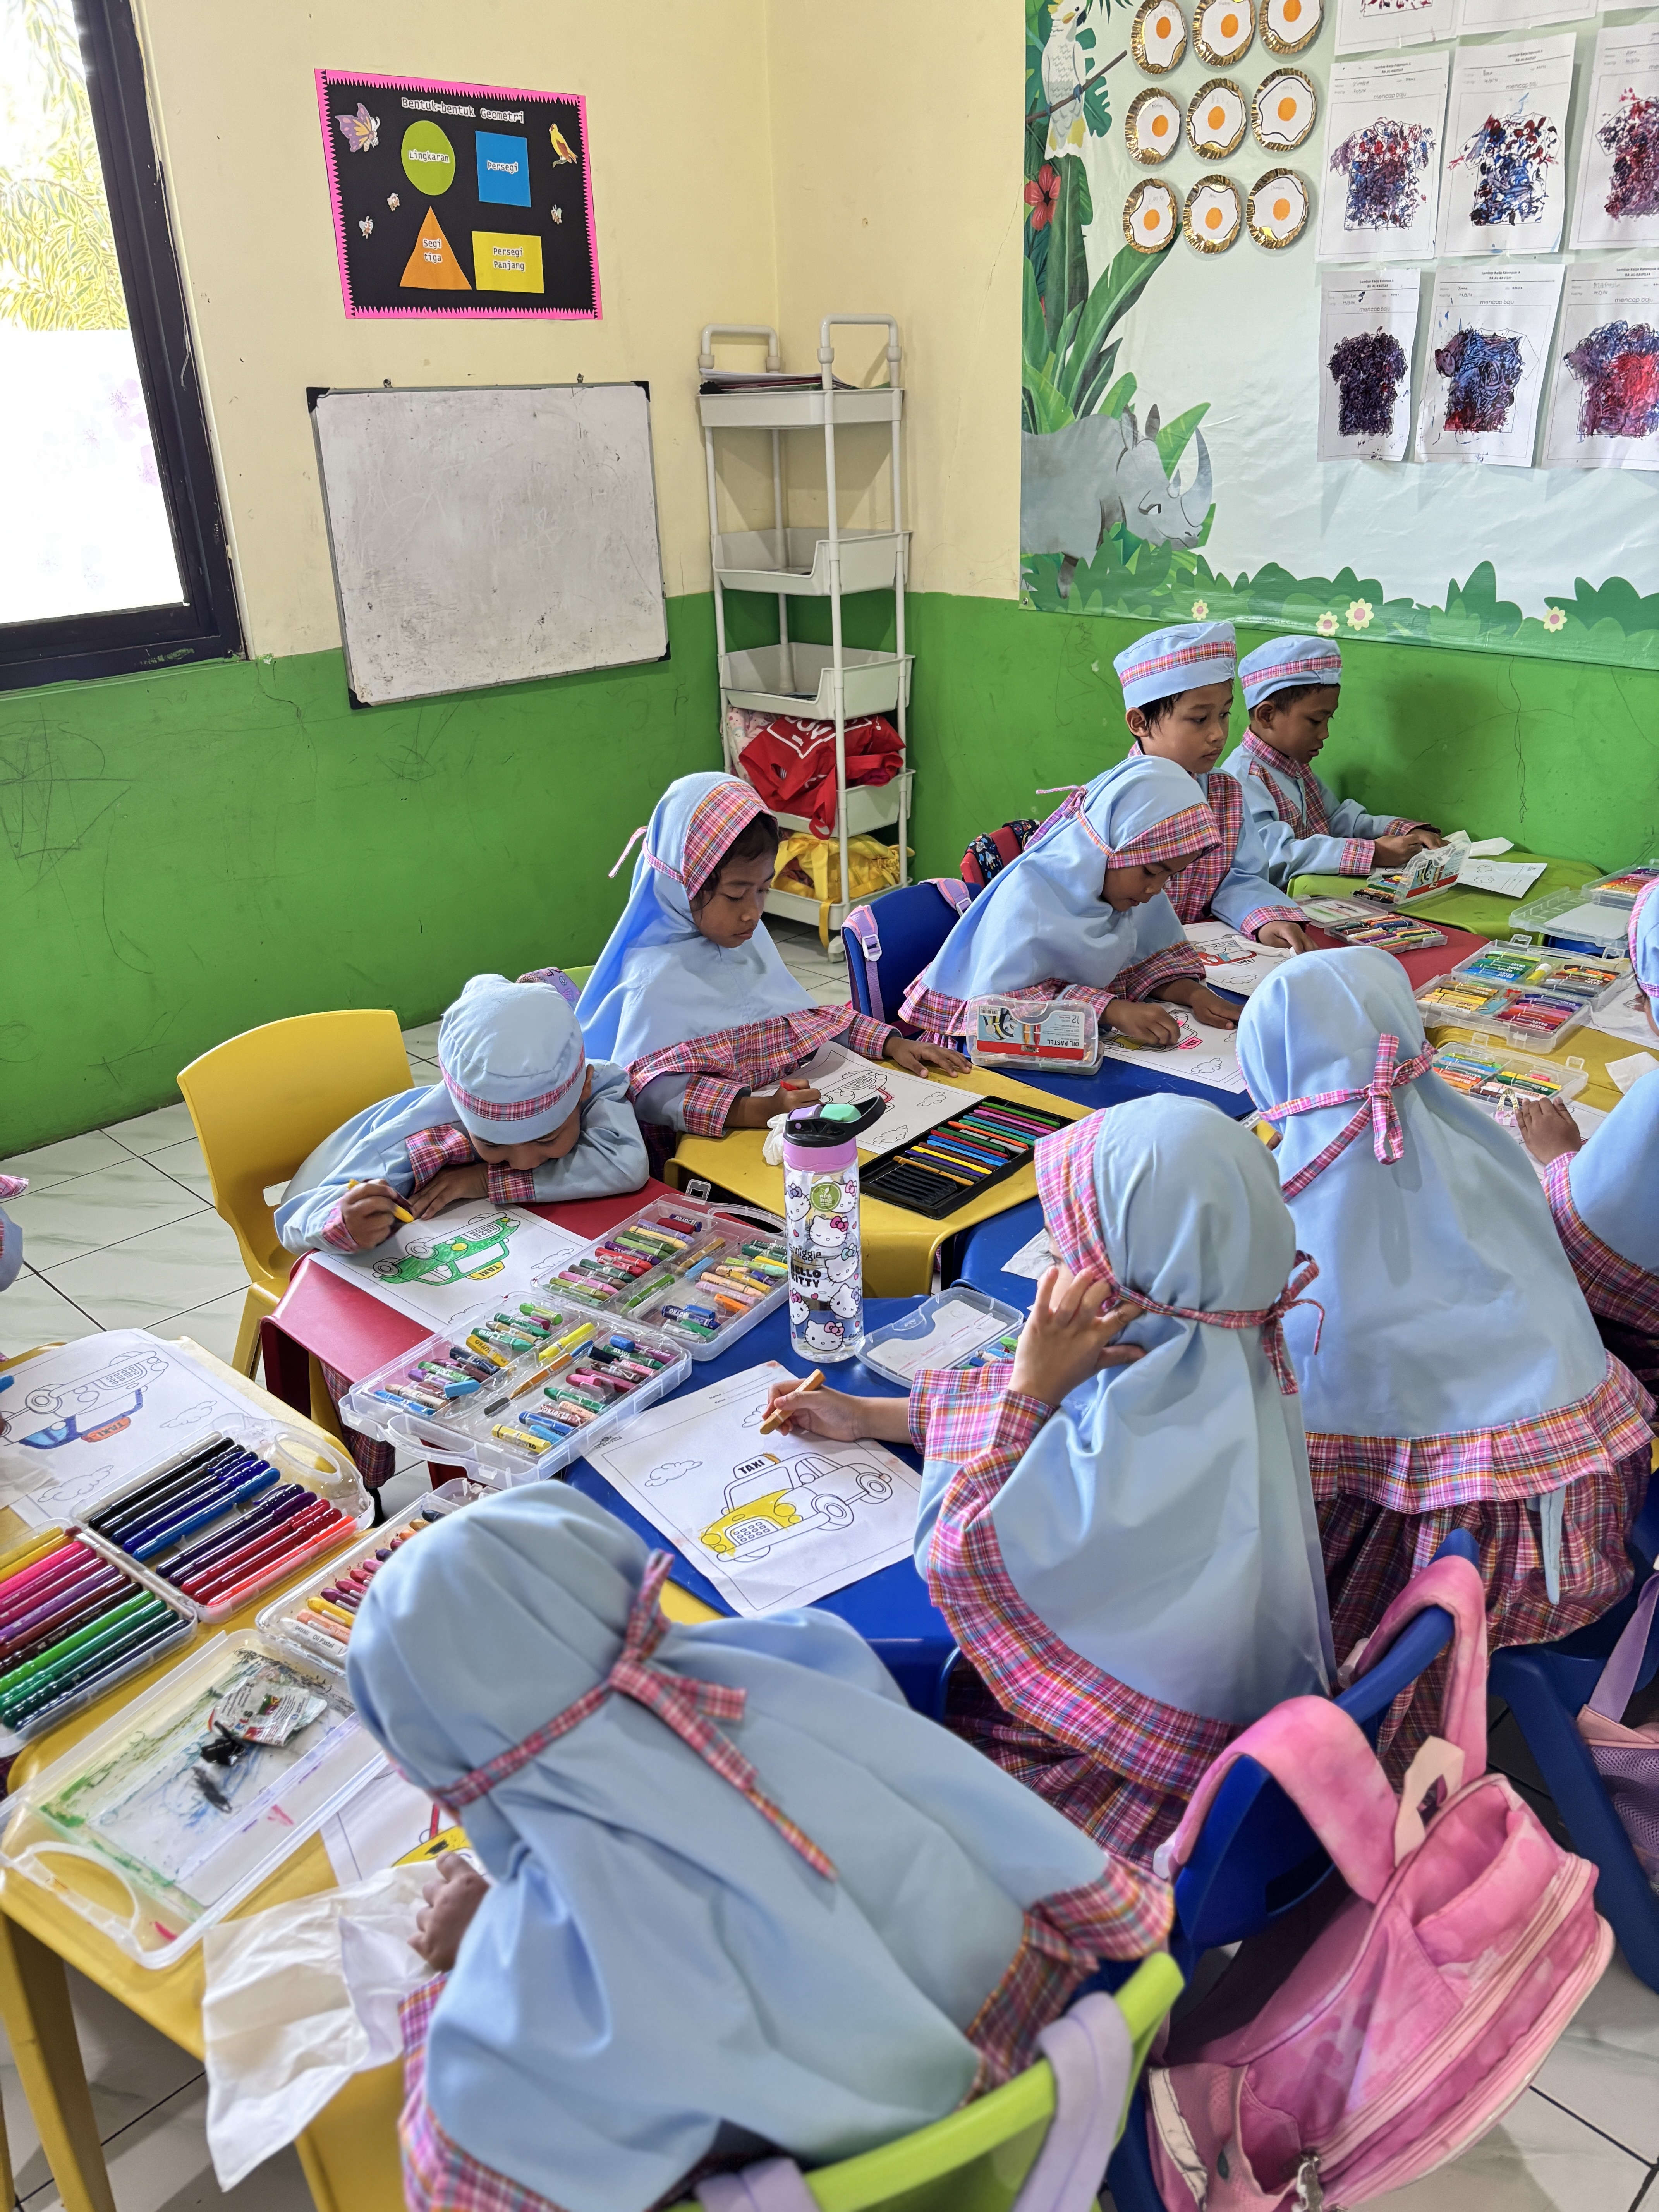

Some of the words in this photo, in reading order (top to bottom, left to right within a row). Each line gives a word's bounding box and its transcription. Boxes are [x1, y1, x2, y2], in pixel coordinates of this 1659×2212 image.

[402, 98, 475, 116] Bentuk-bentuk
[481, 109, 524, 123] Geometri
[409, 150, 449, 162] Lingkaran
[488, 162, 518, 173] Persegi
[424, 240, 441, 249] Segi
[493, 247, 523, 257] Persegi
[424, 254, 442, 263] tiga
[494, 261, 524, 271] Panjang
[1072, 1015, 1079, 1024] 12
[478, 1265, 501, 1276] TAXI
[669, 1309, 683, 1317] OYKO
[613, 1348, 631, 1357] JOYKO
[97, 1422, 124, 1436] TAXI
[737, 1459, 765, 1474] TAXI
[318, 1638, 335, 1649] Pastel
